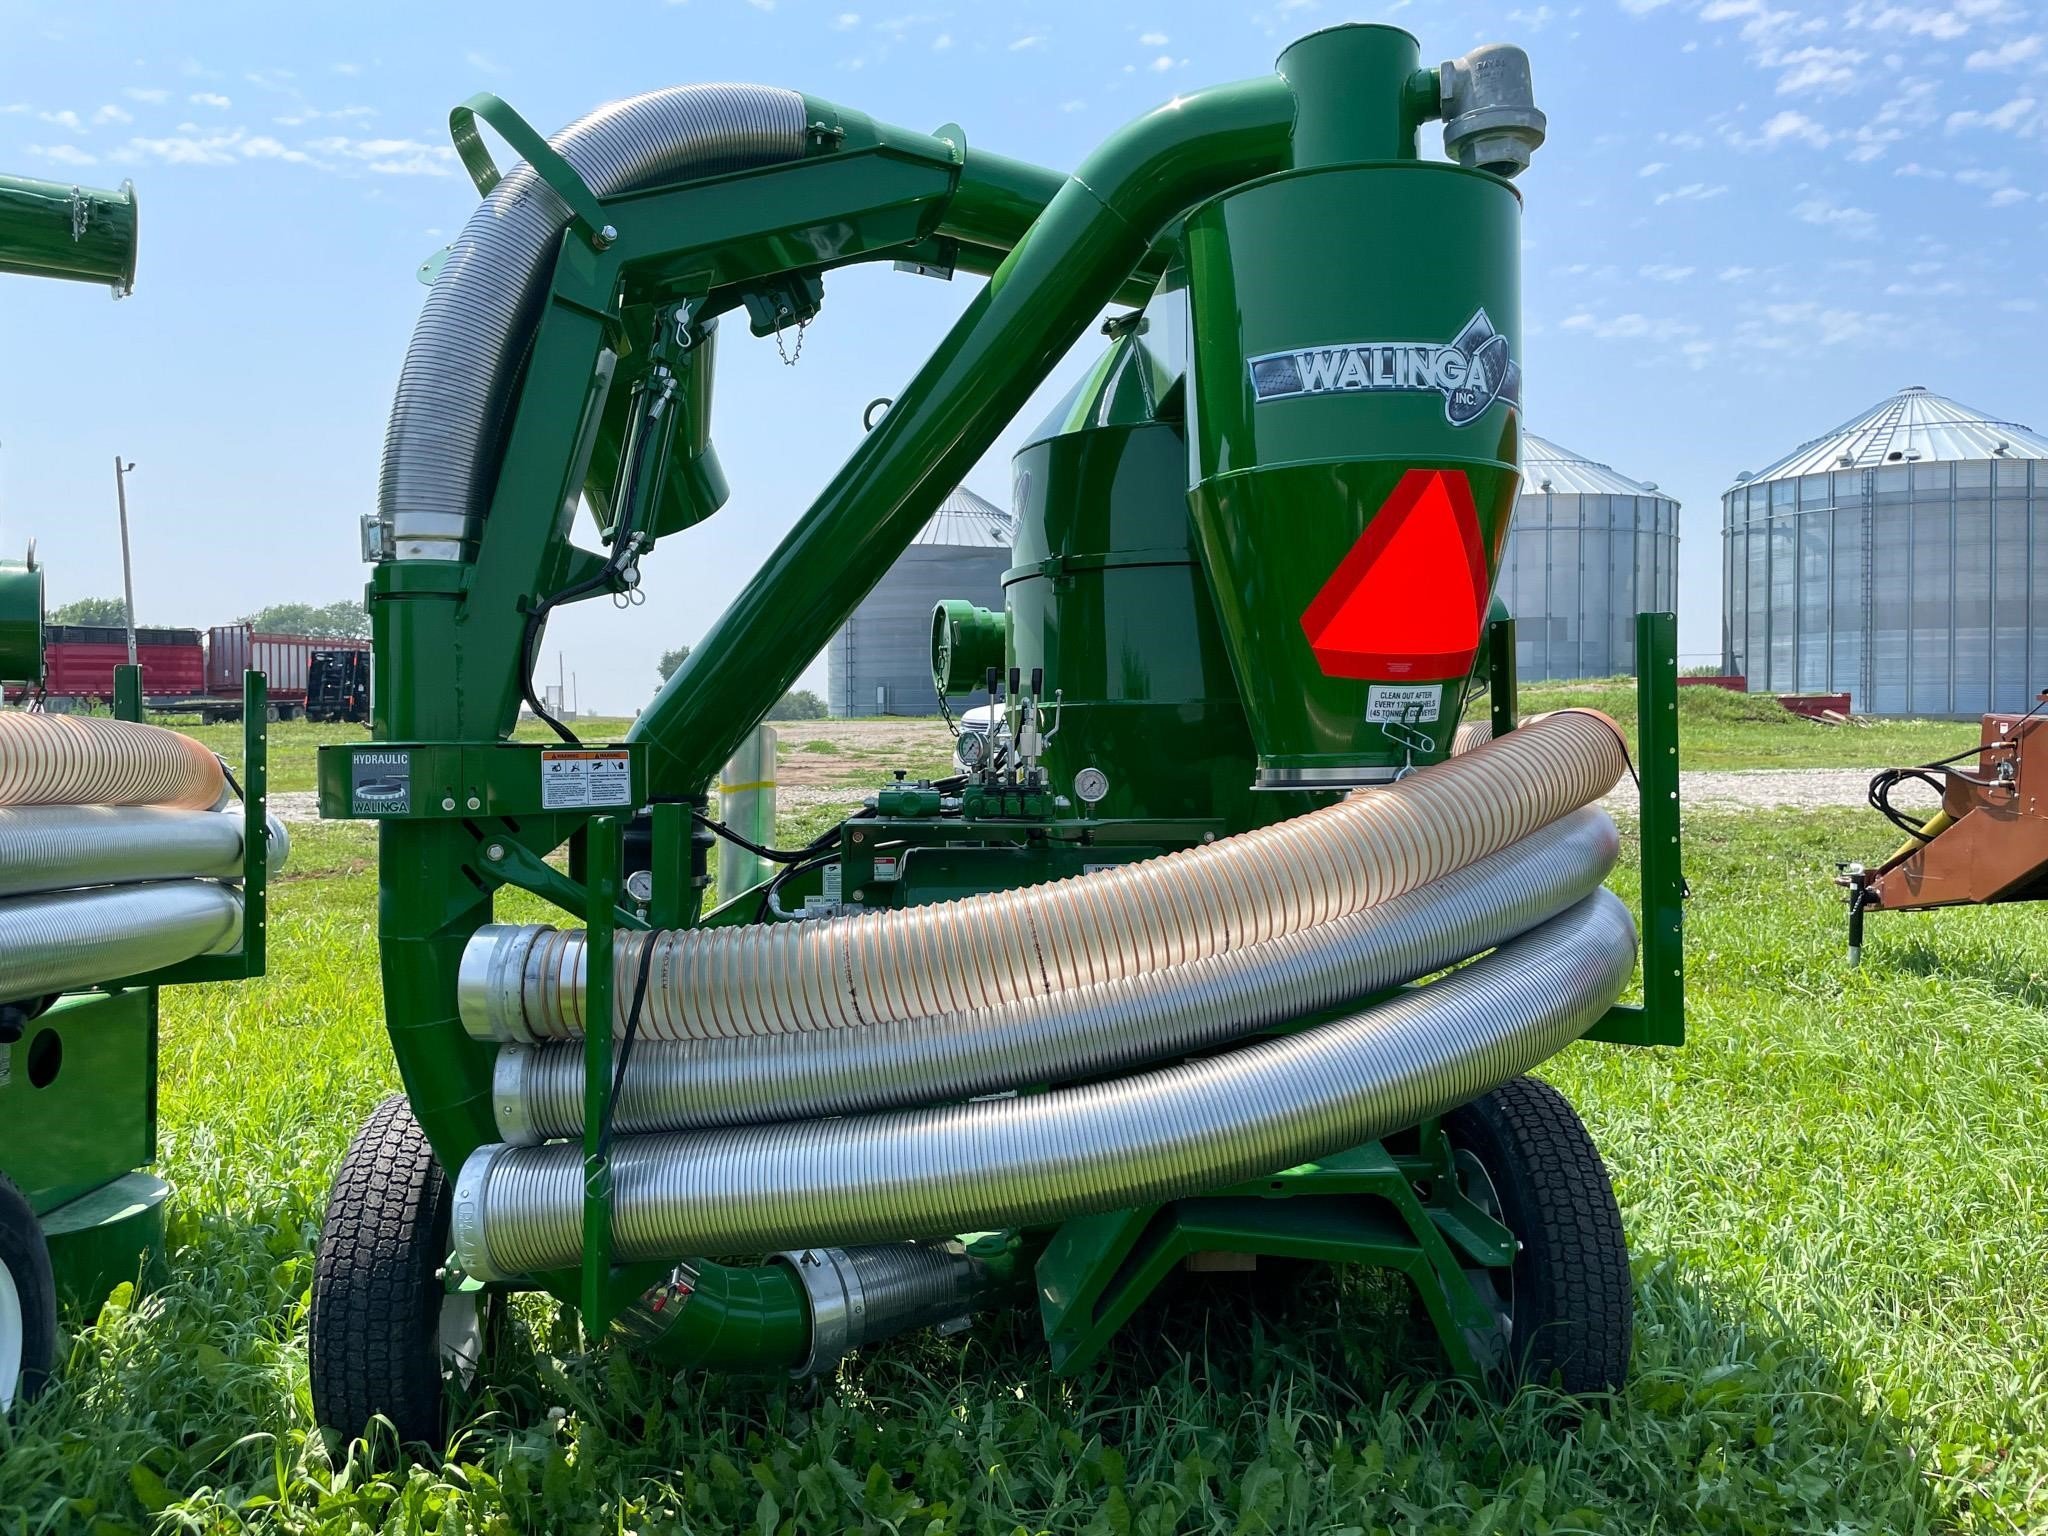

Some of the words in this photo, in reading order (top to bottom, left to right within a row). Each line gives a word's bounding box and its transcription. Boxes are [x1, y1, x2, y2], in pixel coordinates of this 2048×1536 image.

[1297, 347, 1488, 392] WALINGA
[1455, 391, 1477, 406] INC.
[1380, 691, 1401, 699] CLEAN
[1401, 691, 1414, 700] OUT
[1415, 691, 1433, 699] AFTER
[1374, 700, 1395, 708] EVERY
[1370, 709, 1381, 718] (45
[1409, 708, 1437, 717] COVEYED
[353, 754, 408, 765] HYDRAULIC
[354, 800, 409, 813] WALINGA
